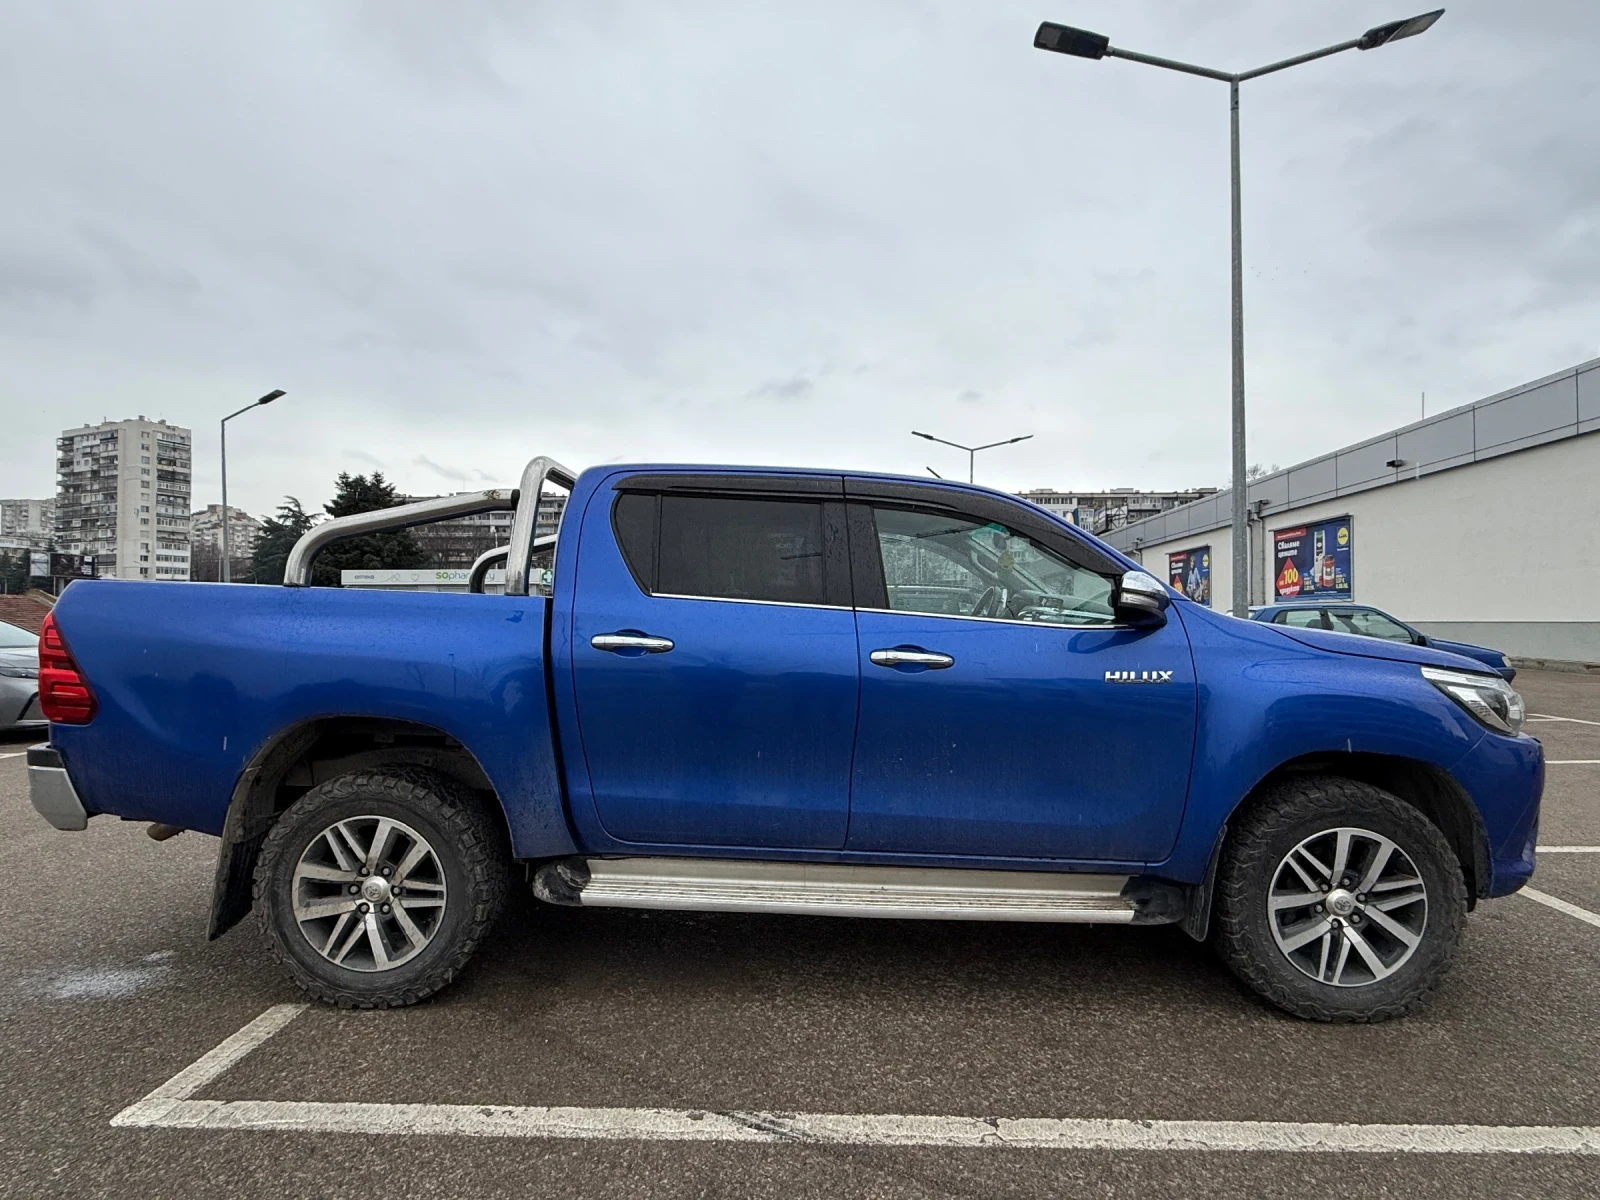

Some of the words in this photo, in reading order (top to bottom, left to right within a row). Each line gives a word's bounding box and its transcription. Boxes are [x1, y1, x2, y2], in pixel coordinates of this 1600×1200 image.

[436, 571, 495, 581] sopharcy
[1284, 568, 1298, 584] 100
[1105, 671, 1173, 683] HILUX
